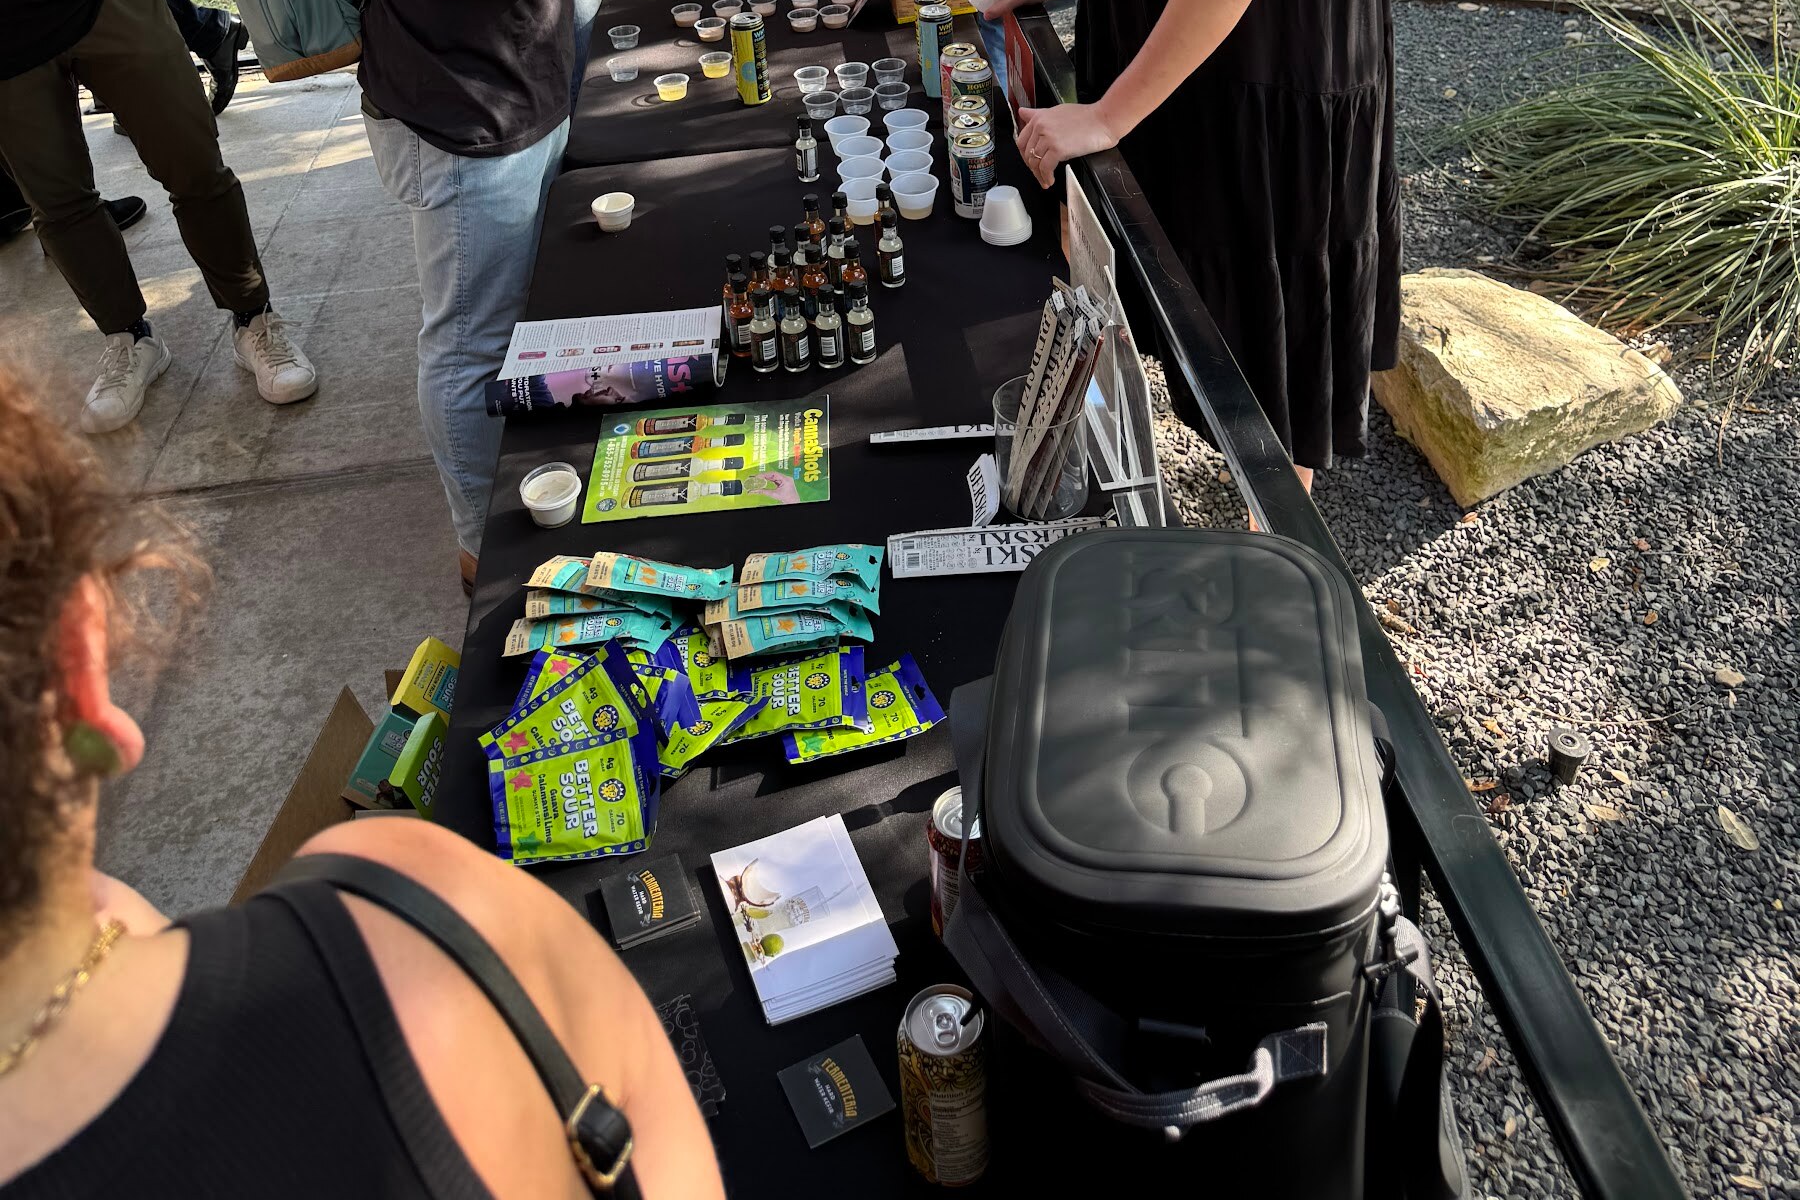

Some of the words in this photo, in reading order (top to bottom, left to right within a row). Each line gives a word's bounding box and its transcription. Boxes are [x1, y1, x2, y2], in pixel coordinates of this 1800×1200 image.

[804, 408, 823, 482] CannaShots
[969, 466, 988, 522] BERSKI
[588, 686, 599, 700] 4g
[772, 672, 785, 709] SOUR
[786, 665, 801, 717] BETTER
[818, 696, 827, 707] 70
[889, 712, 899, 723] 70
[417, 736, 442, 786] SOUR
[605, 757, 614, 770] 4g
[538, 774, 551, 821] Calamansi
[549, 789, 559, 820] Guava
[559, 772, 581, 831] SOUR
[574, 759, 599, 839] BETTER
[544, 822, 553, 844] Lime
[616, 812, 625, 826] 70
[814, 1077, 826, 1097] WATER
[823, 1097, 835, 1114] KEFIR
[821, 1057, 858, 1117] FERMENTERIA
[825, 1084, 836, 1101] HARD
